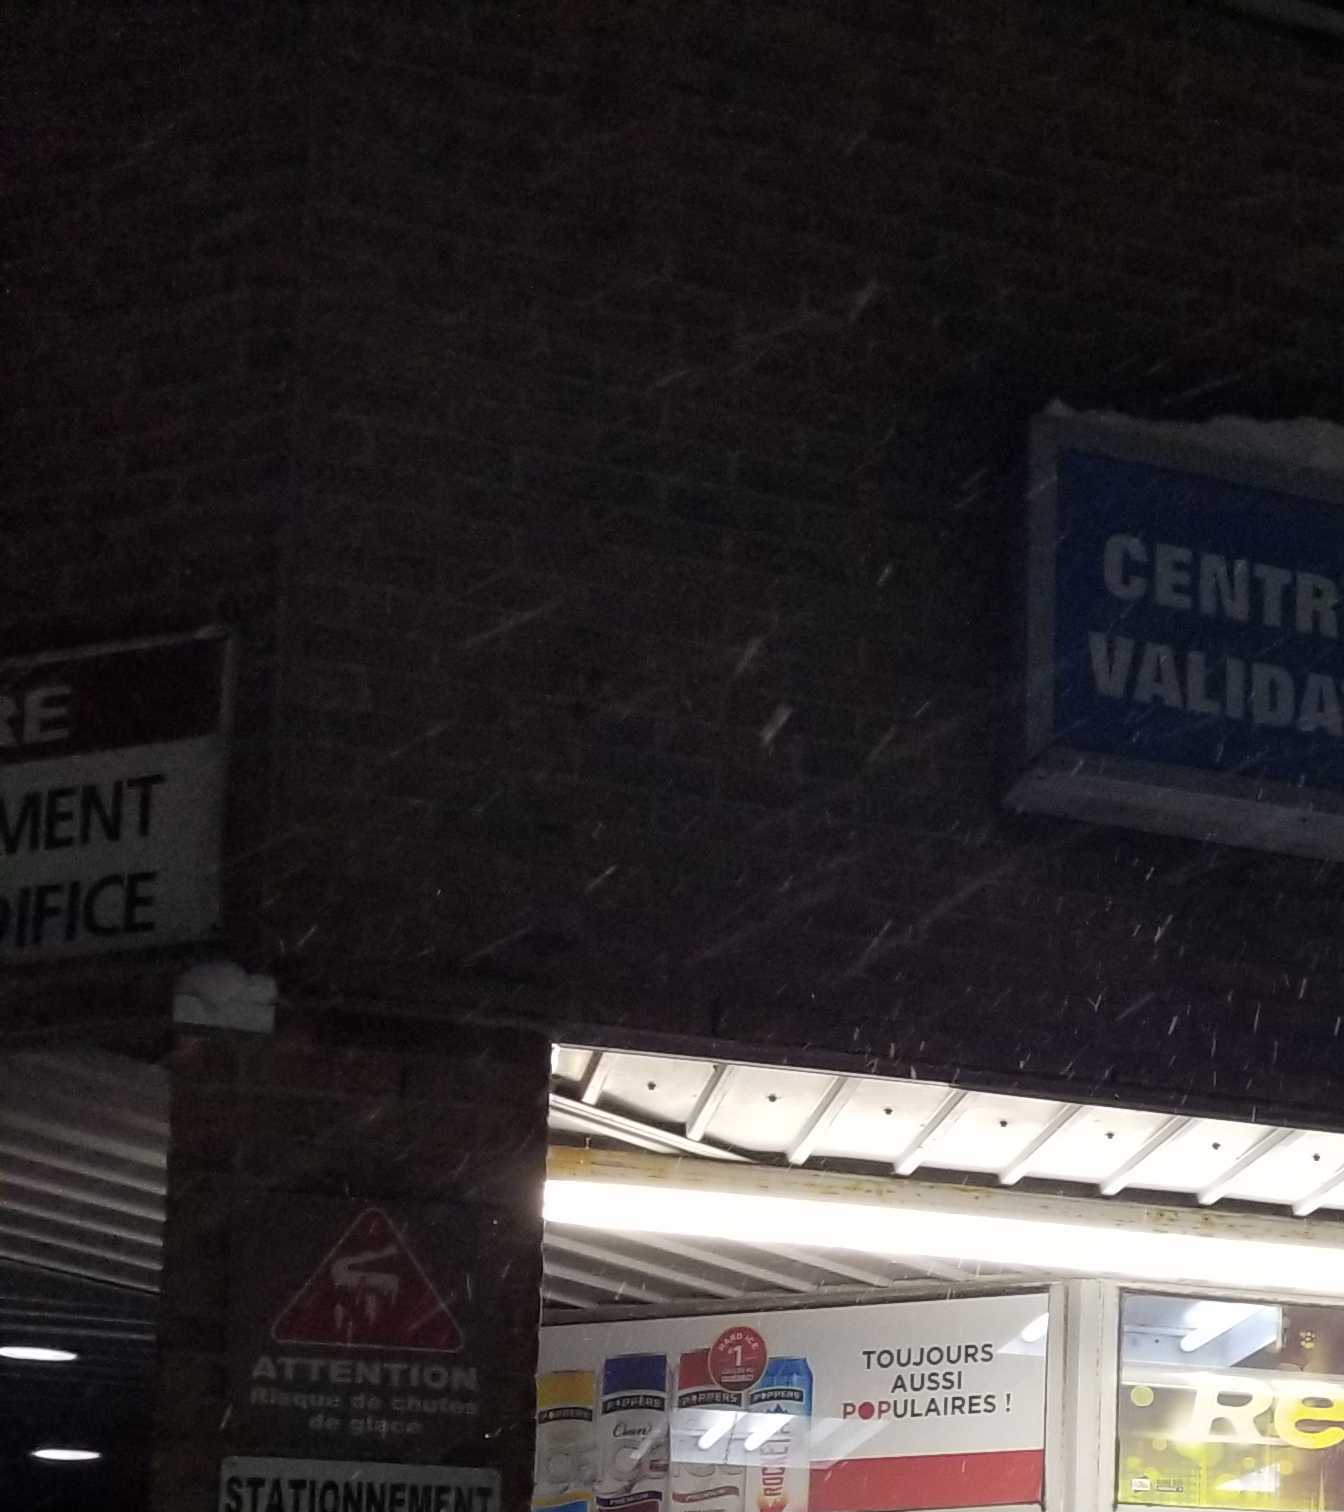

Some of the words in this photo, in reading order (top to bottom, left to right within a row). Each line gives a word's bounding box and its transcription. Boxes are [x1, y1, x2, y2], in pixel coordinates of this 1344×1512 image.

[862, 1344, 994, 1370] TOUJOURS
[252, 1355, 480, 1392] ATTENTION
[890, 1372, 963, 1394] AUSSI
[842, 1395, 996, 1421] POPULAIRES
